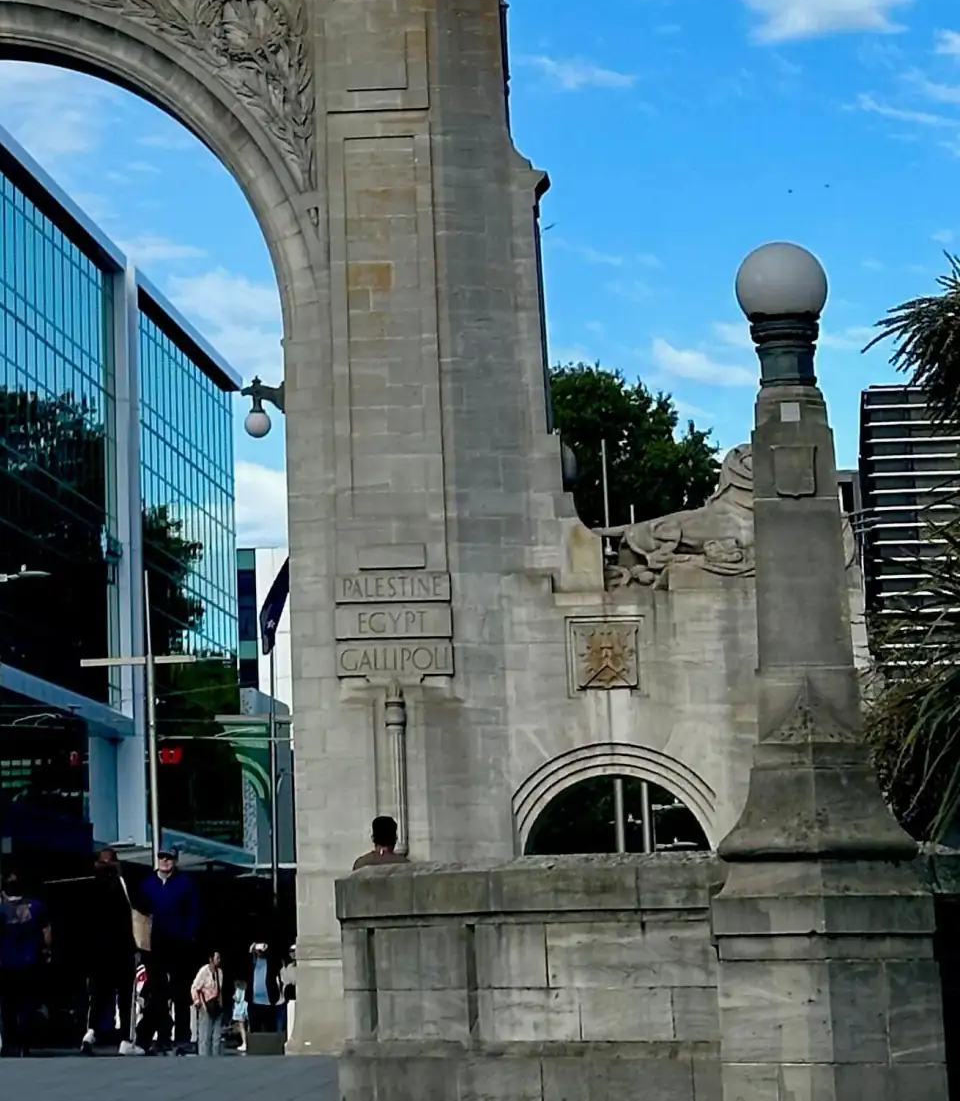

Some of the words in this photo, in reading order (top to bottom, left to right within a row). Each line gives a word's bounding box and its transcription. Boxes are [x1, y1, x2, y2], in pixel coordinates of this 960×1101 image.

[342, 575, 442, 598] PALESTINE
[357, 610, 428, 634] EGYPT
[340, 646, 448, 672] GALLIPOLI
